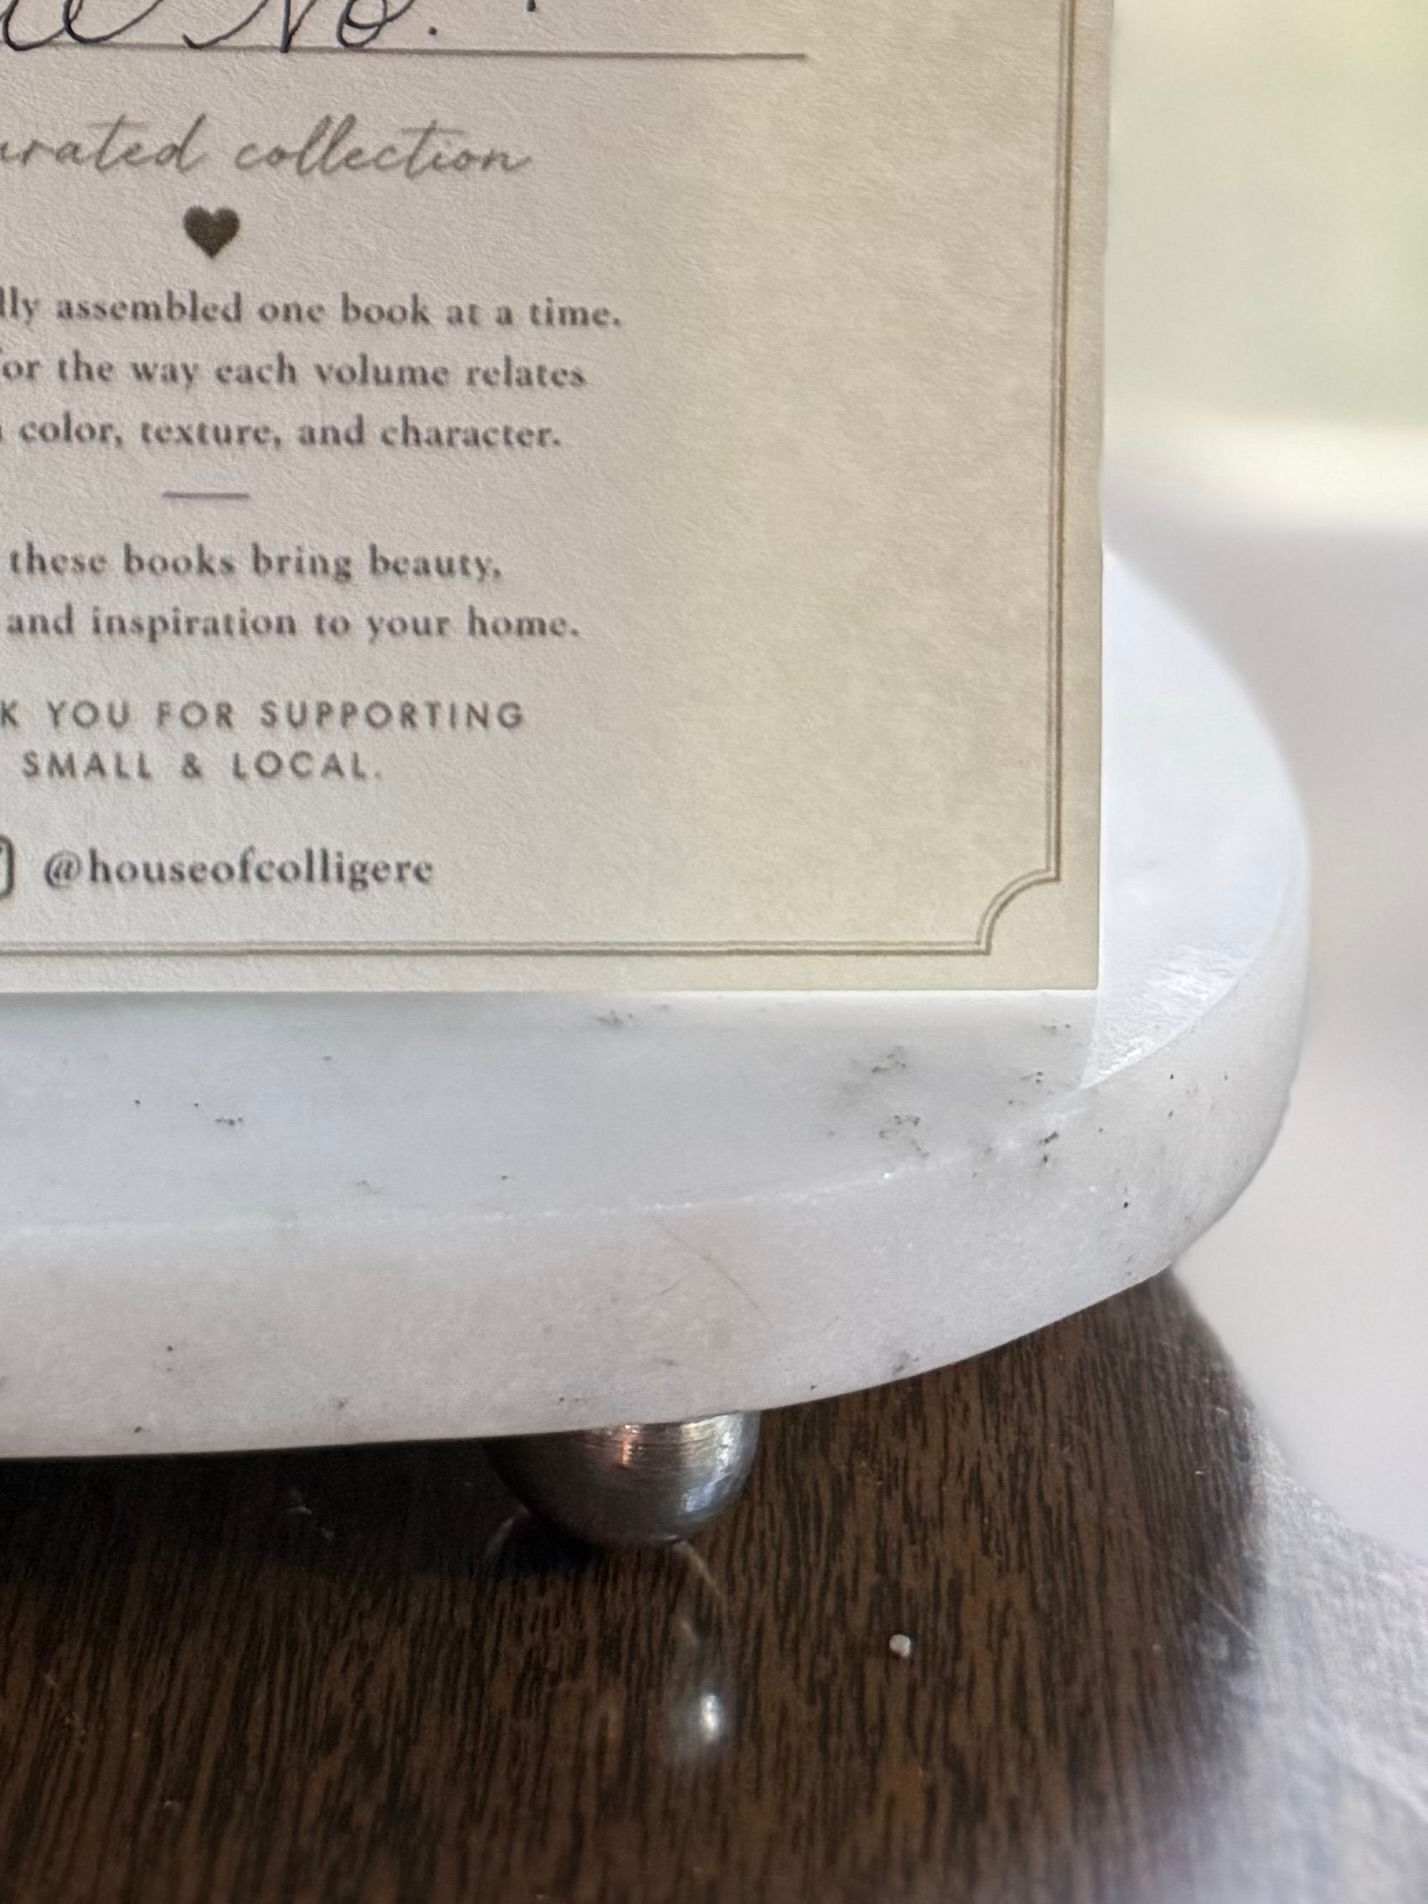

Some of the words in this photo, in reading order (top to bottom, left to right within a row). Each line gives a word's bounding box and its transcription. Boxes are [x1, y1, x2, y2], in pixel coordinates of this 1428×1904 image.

[234, 113, 533, 181] collection
[56, 289, 243, 324] assembled
[257, 302, 325, 325] one
[341, 291, 431, 326] book
[446, 303, 480, 327] at
[495, 306, 514, 327] a
[529, 296, 622, 328] time.
[57, 348, 114, 383] the
[131, 362, 199, 390] way
[215, 351, 298, 386] each
[314, 352, 450, 388] volume
[466, 354, 587, 389] relates
[18, 410, 124, 449] color,
[140, 422, 282, 450] texture,
[298, 413, 366, 448] and
[380, 414, 561, 449] character.
[9, 540, 107, 576] these
[123, 542, 236, 577] books
[251, 541, 353, 585] bring
[368, 542, 502, 584] beauty,
[6, 602, 75, 637] and
[92, 606, 297, 646] inspiration
[315, 613, 352, 637] to
[366, 616, 450, 644] your
[468, 605, 579, 639] home.
[46, 700, 131, 731] YOU
[156, 700, 234, 730] FOR
[260, 700, 525, 731] SUPPORTING
[22, 750, 152, 781] SMALL
[180, 752, 204, 780] &
[232, 750, 384, 782] LOCAL.
[43, 845, 434, 893] @houseofcolligere
